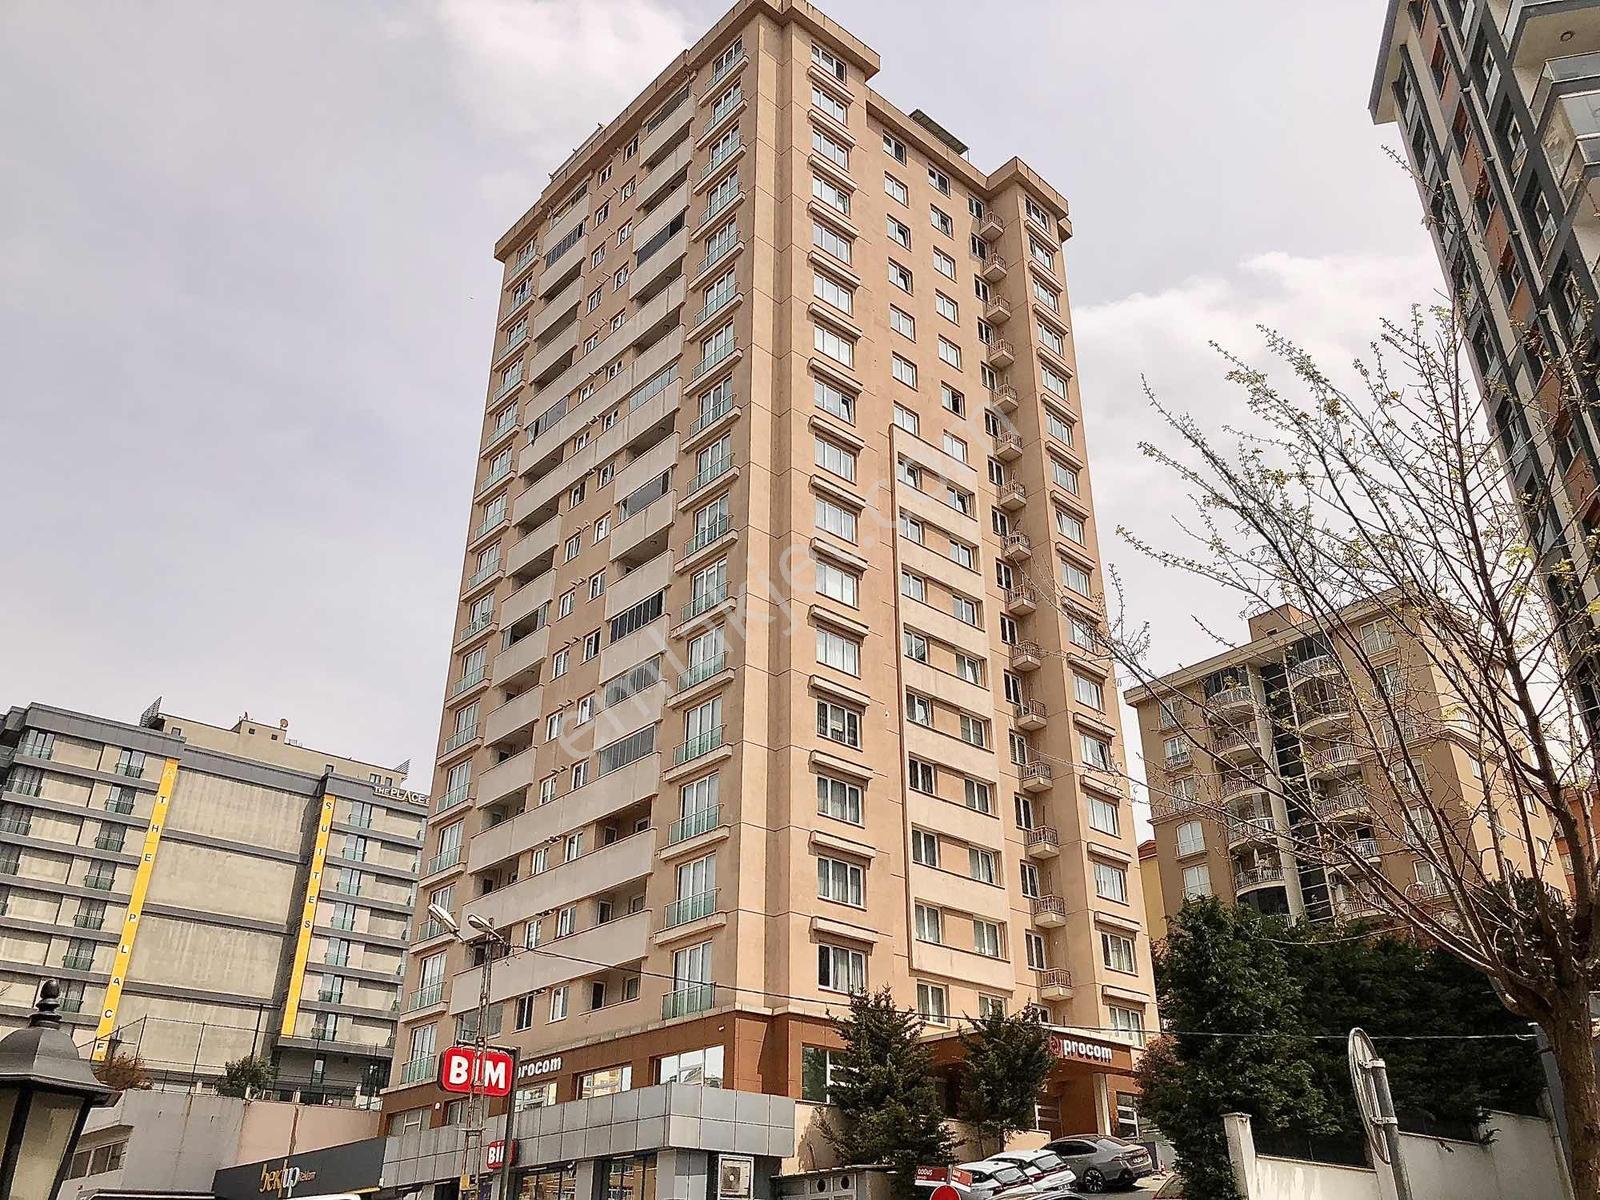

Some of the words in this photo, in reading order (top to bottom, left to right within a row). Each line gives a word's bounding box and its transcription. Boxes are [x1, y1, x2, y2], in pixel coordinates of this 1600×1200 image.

[374, 786, 390, 796] THE
[391, 788, 424, 803] PLACE
[144, 796, 167, 862] THE
[304, 802, 332, 928] SUITES
[1063, 1039, 1113, 1060] procom
